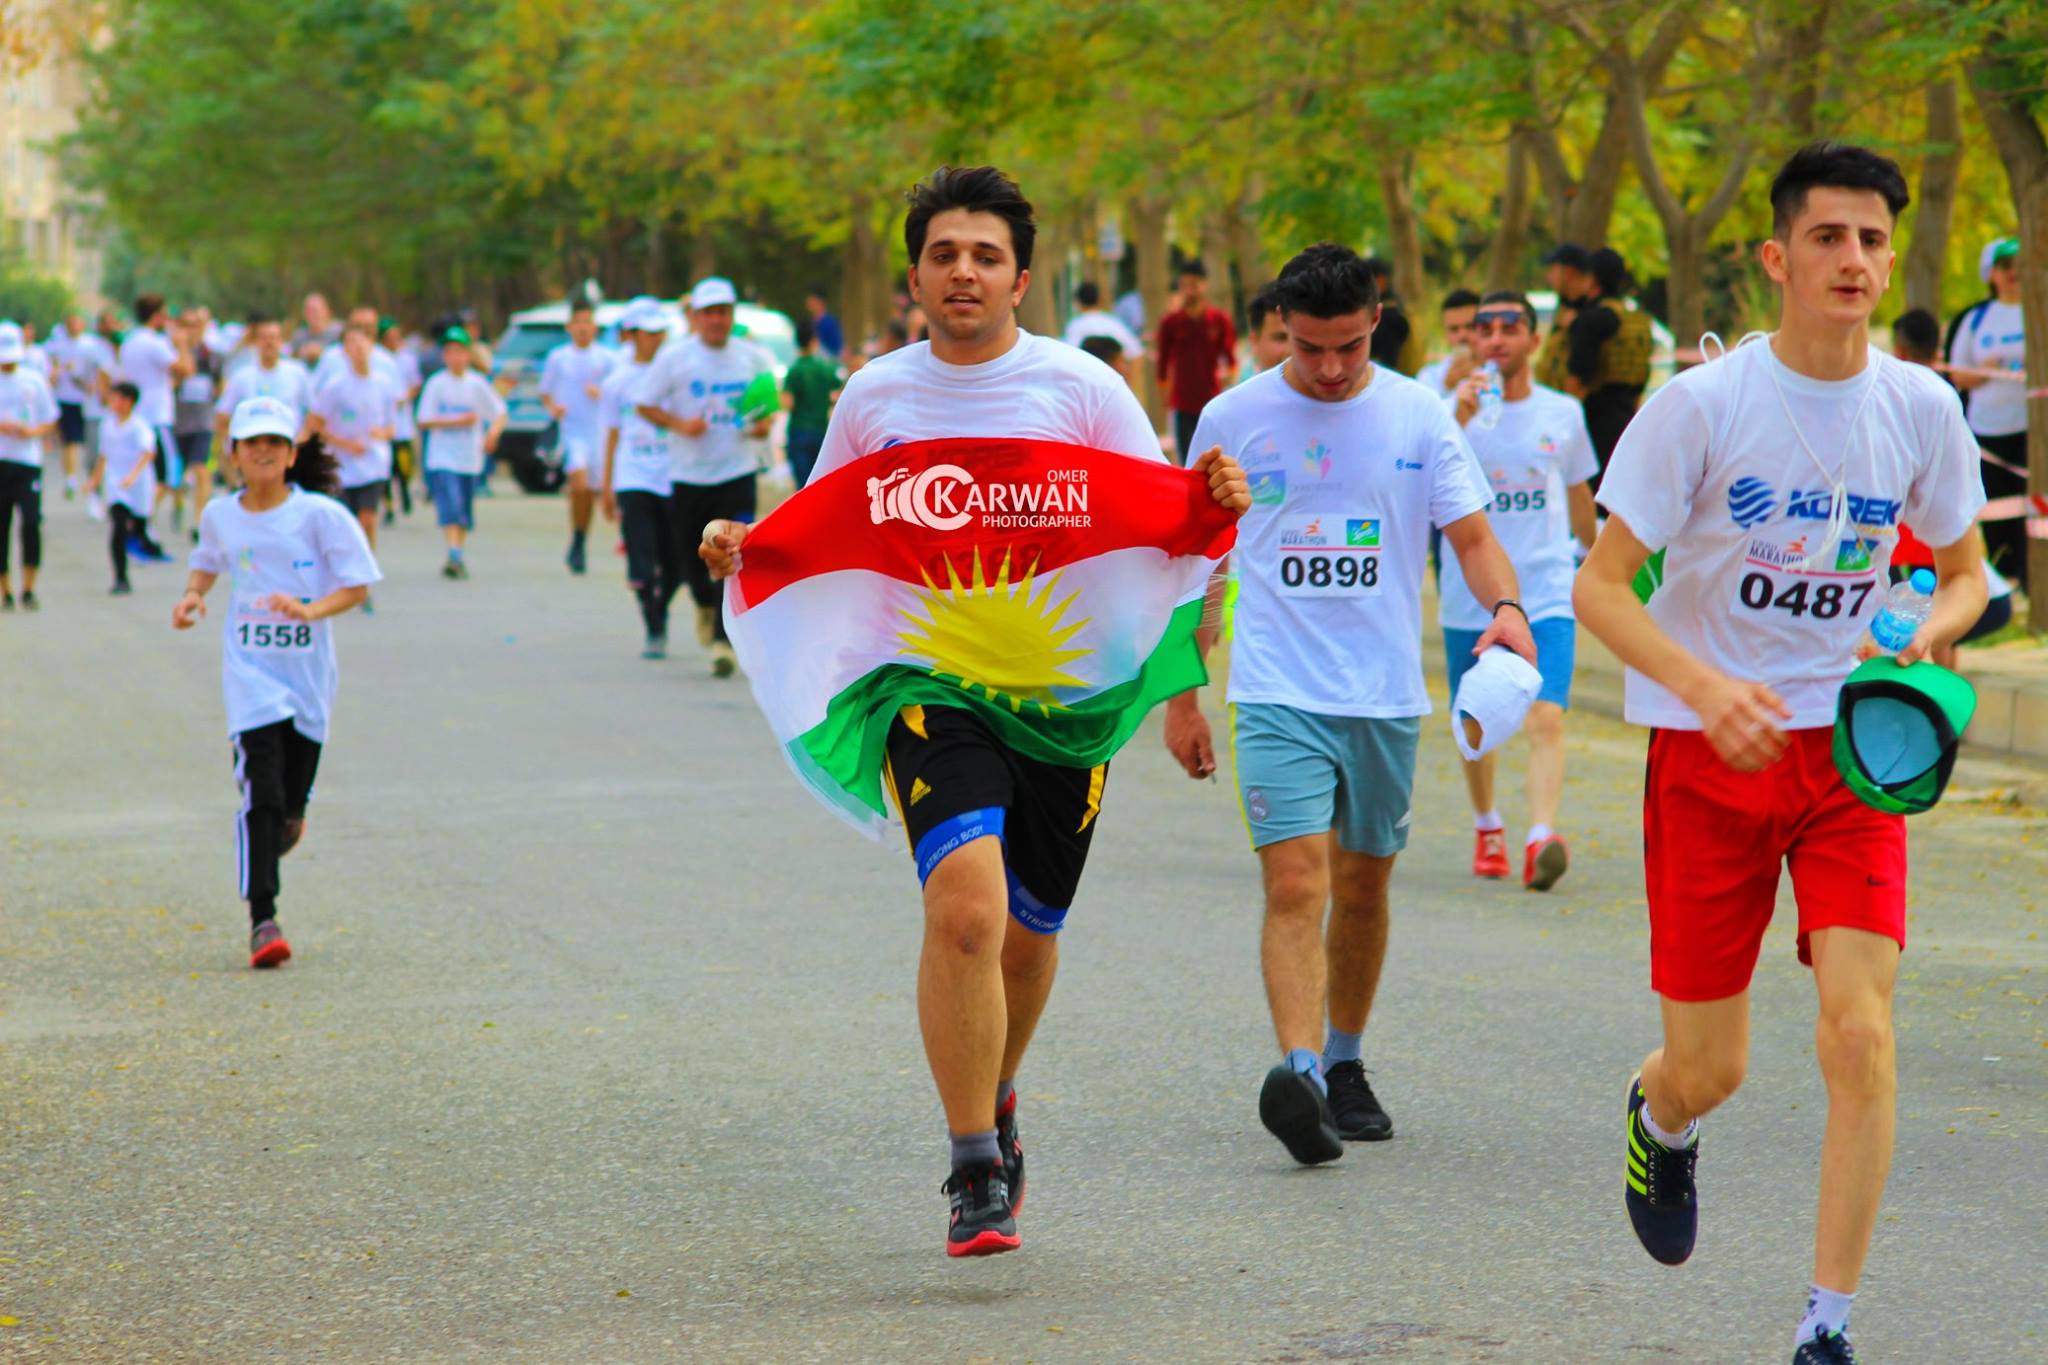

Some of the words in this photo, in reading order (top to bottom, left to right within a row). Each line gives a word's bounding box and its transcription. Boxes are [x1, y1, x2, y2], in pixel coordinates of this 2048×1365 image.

[1281, 556, 1379, 588] 0898
[1740, 571, 1876, 620] 0487
[238, 623, 312, 648] 1558
[926, 836, 959, 870] STRONG
[960, 823, 984, 841] BODY
